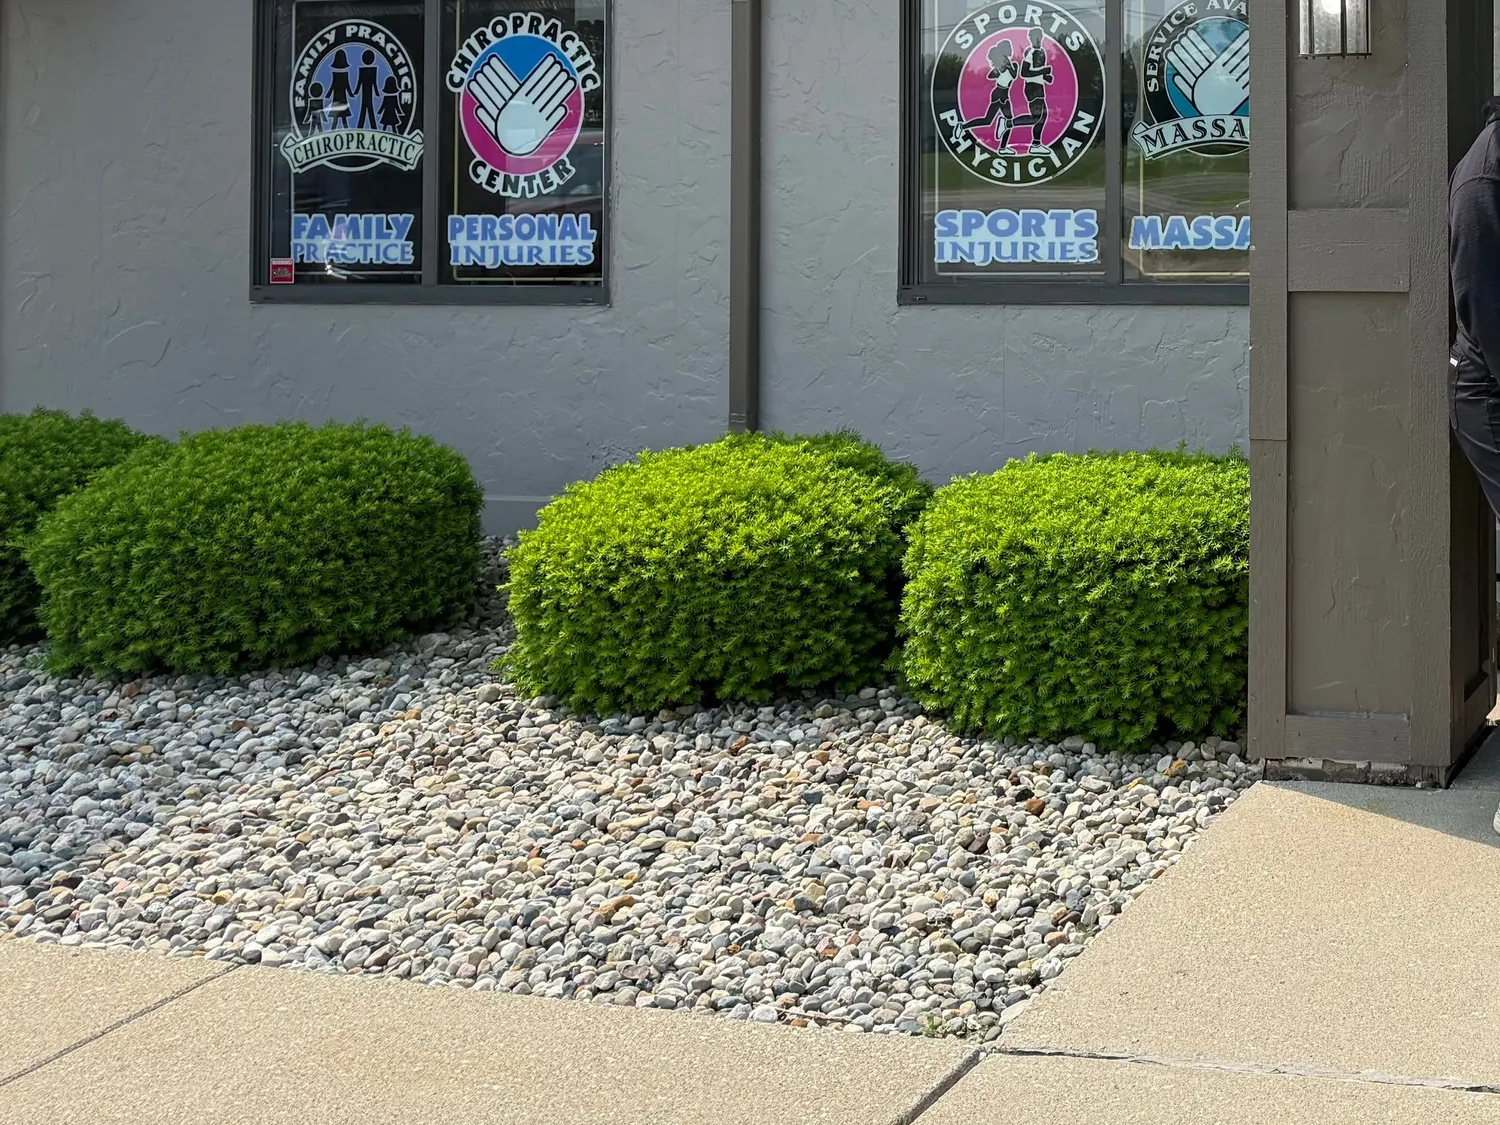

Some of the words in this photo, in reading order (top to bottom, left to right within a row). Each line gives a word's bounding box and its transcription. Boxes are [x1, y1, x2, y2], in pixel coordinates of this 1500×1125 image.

[954, 3, 1085, 52] SPORTS
[447, 13, 600, 92] CHIROPRACTIC
[1147, 2, 1198, 93] SERVICE
[295, 29, 336, 108] FAMILY
[345, 24, 413, 106] PRACTICE
[293, 132, 416, 166] CHIROPRACTIC
[938, 108, 1096, 182] PHYSICIAN
[470, 158, 575, 196] CENTER
[291, 214, 414, 241] FAMILY
[448, 214, 598, 242] PERSONAL
[935, 209, 1098, 238] SPORTS
[291, 241, 414, 263] PRACTICE
[450, 244, 594, 268] INJURIES
[935, 239, 1098, 263] INJURIES
